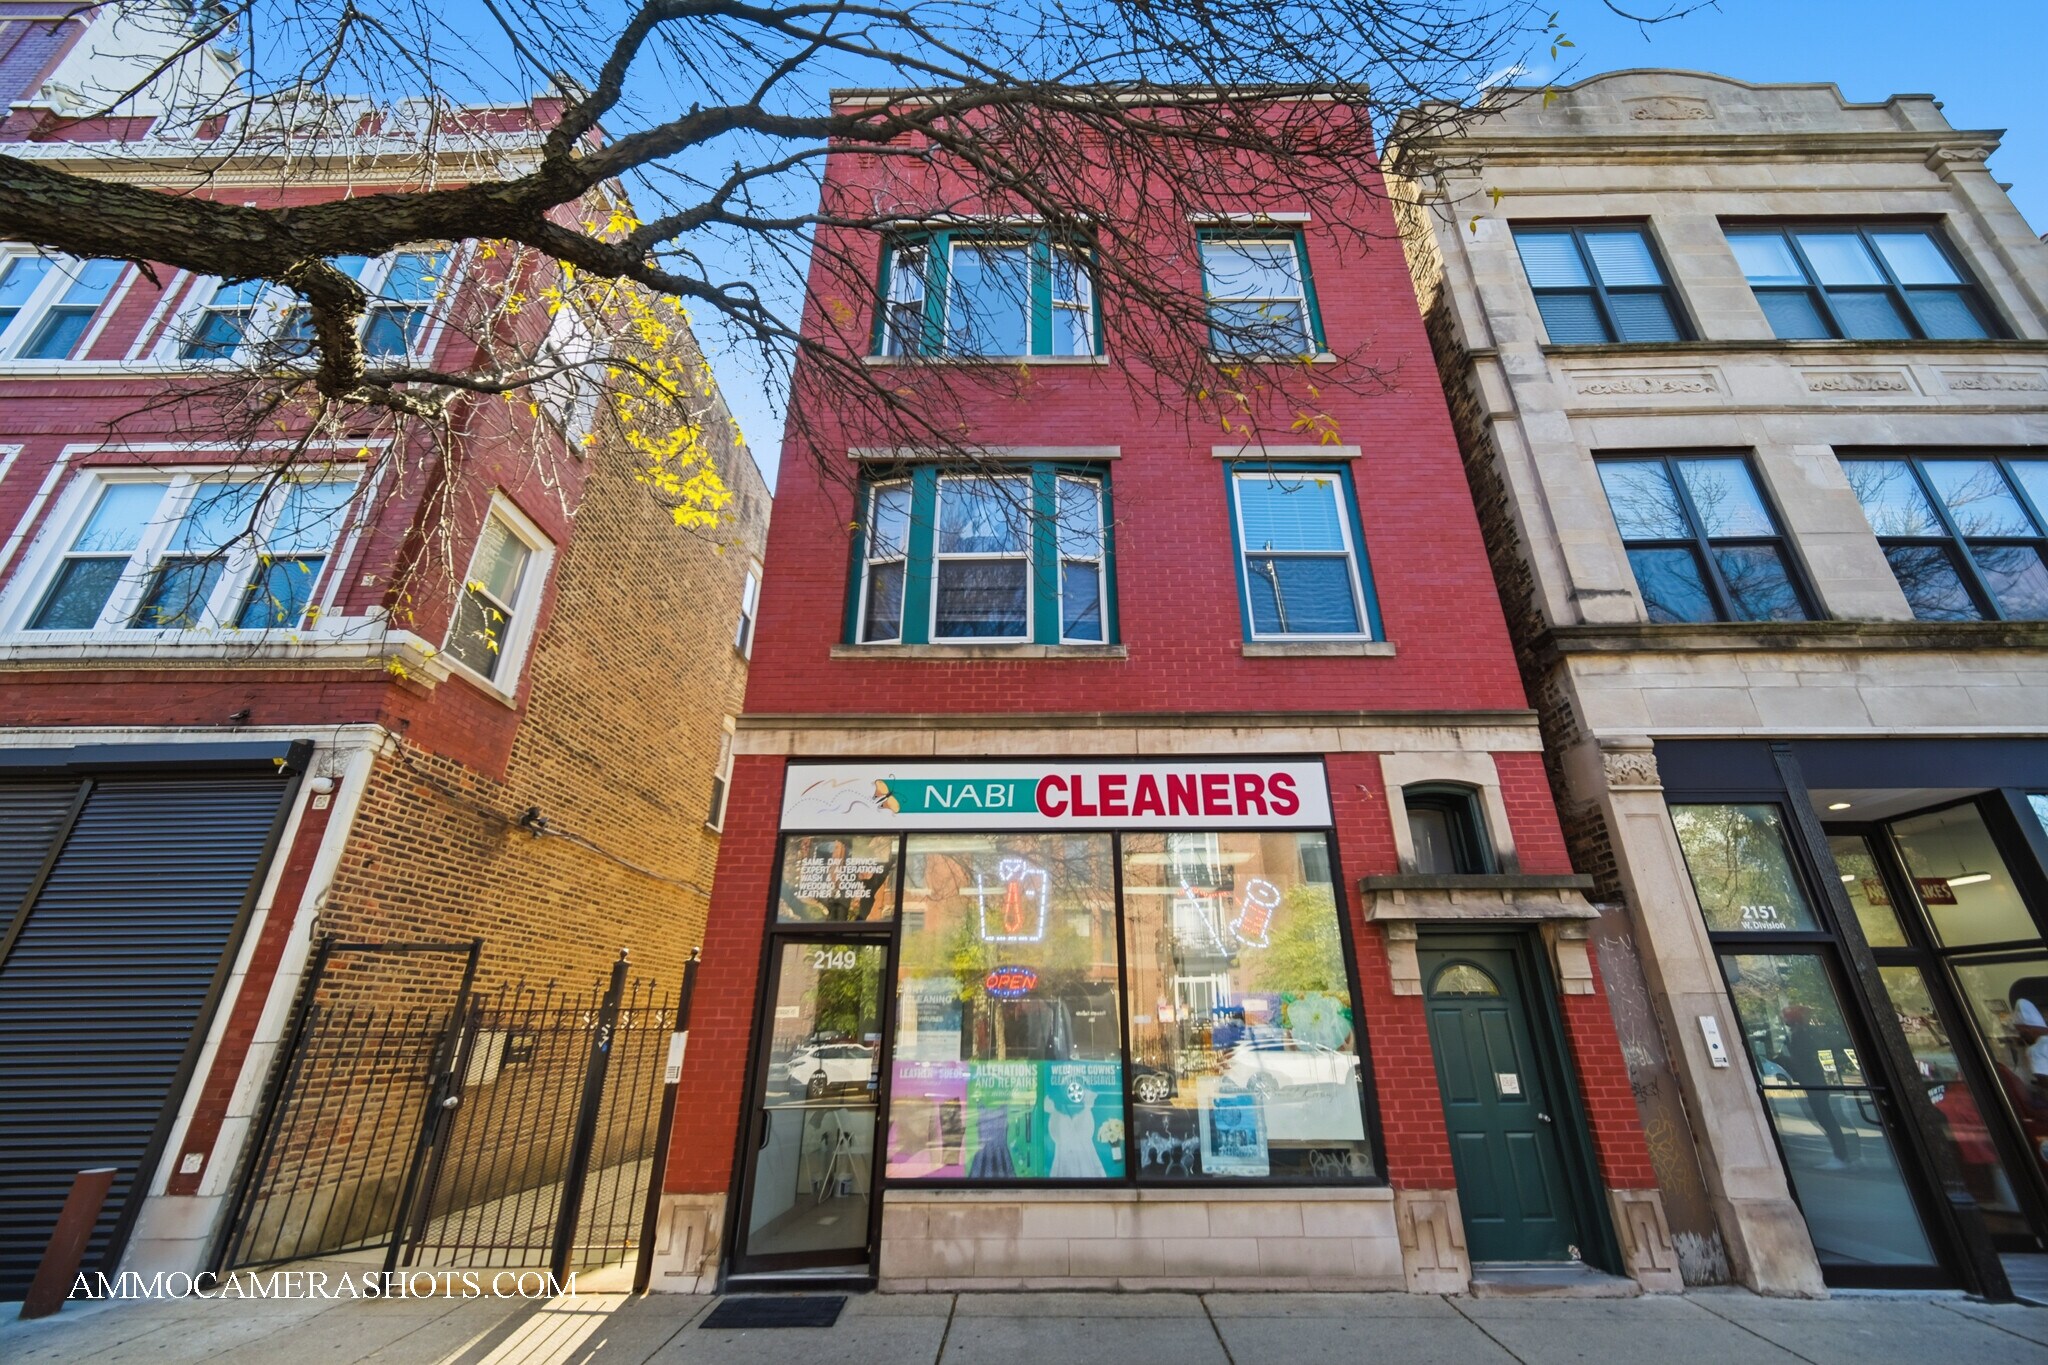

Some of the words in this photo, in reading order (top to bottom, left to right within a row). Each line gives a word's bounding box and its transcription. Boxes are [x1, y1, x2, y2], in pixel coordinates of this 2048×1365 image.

[924, 783, 1014, 809] NABI
[1036, 772, 1300, 818] CLEANERS
[802, 857, 825, 866] SAME
[827, 857, 843, 866] DAY
[845, 857, 878, 866] SERVICE
[800, 865, 830, 874] EXPERT
[834, 865, 884, 874] ALTERATIONS
[799, 873, 824, 882] WASH
[826, 874, 832, 882] &
[835, 873, 857, 882] FOLD
[799, 881, 835, 890] WEDDING
[1921, 884, 1952, 898] IKES
[797, 889, 832, 898] LEATHER
[834, 890, 841, 898] &
[844, 889, 871, 898] SUEDE
[1740, 905, 1777, 919] 2151
[813, 950, 856, 969] 2149
[986, 974, 1037, 990] OPEN
[899, 1067, 933, 1079] LEATHER
[939, 1067, 963, 1079] SUEDE
[976, 1064, 1037, 1077] ALTERATIONS
[1051, 1064, 1087, 1075] WEDDING
[1087, 1064, 1116, 1075] GOWNS
[975, 1076, 995, 1088] AND
[998, 1076, 1038, 1089] REPAIRS
